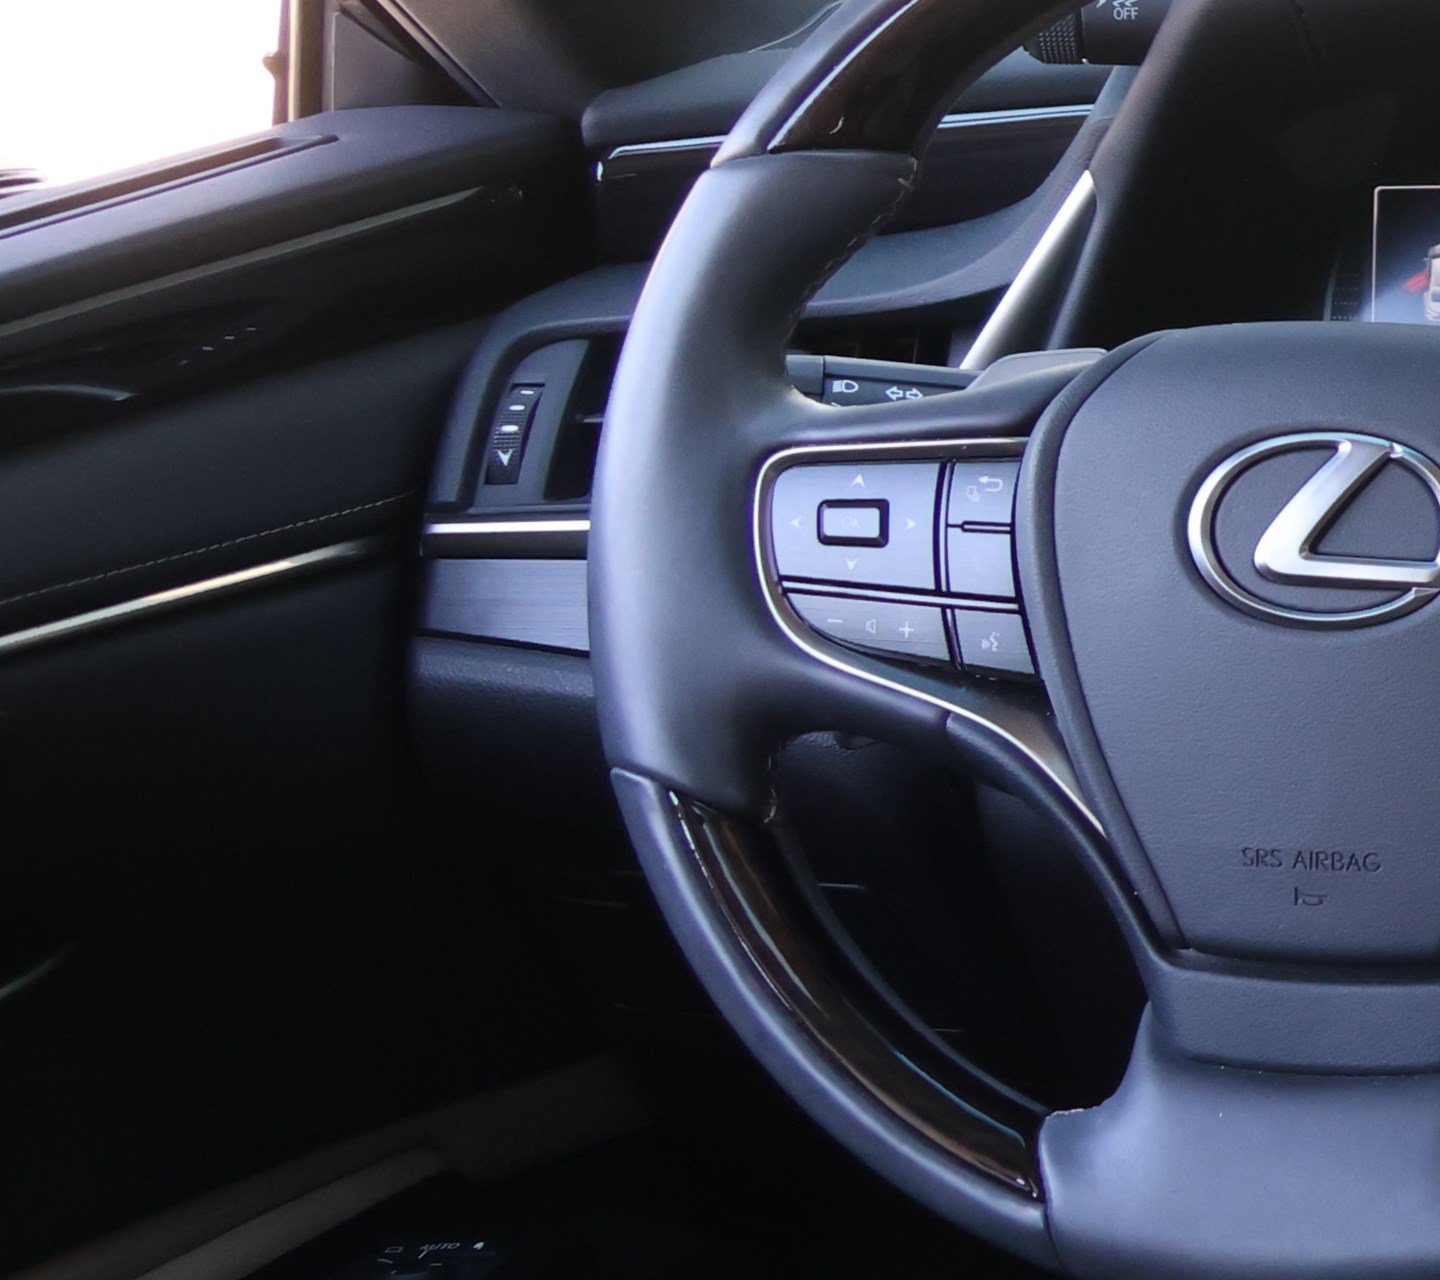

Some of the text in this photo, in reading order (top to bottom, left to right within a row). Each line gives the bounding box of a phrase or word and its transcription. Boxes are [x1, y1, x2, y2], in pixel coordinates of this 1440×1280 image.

[1113, 7, 1139, 20] OFF
[1241, 847, 1382, 873] SRS AIRBAG
